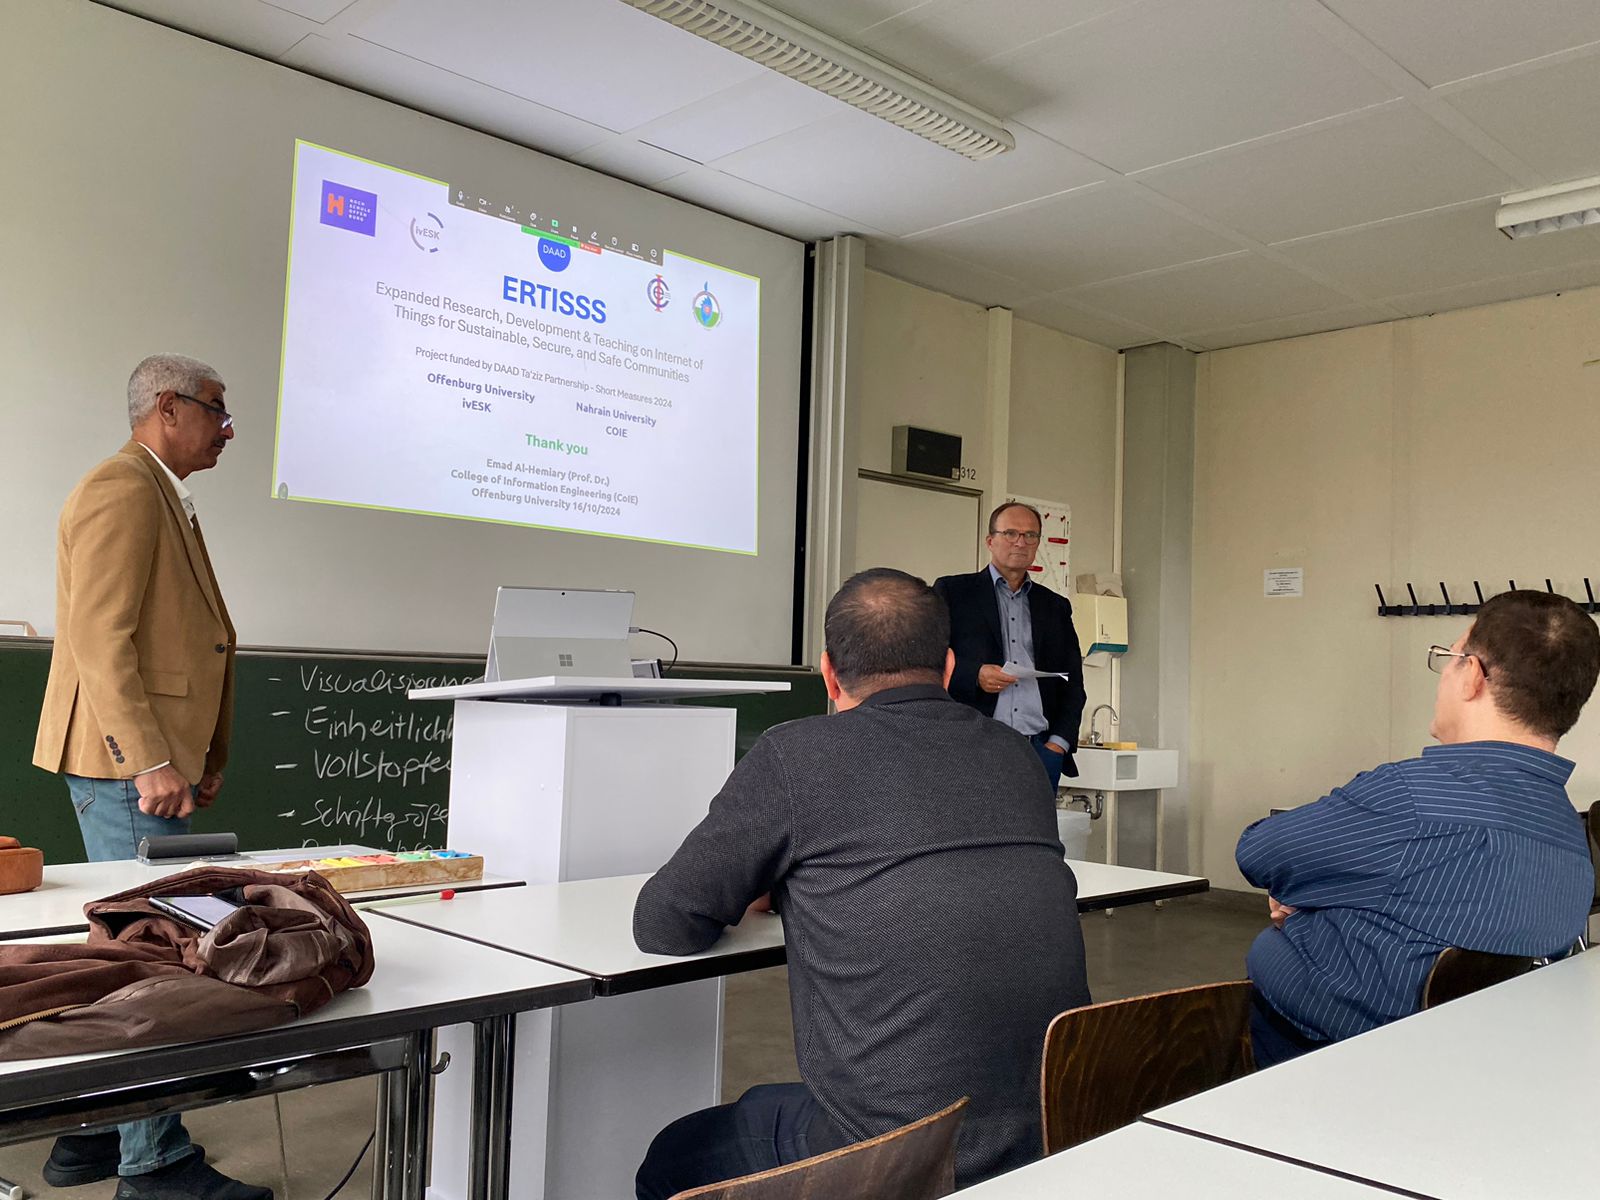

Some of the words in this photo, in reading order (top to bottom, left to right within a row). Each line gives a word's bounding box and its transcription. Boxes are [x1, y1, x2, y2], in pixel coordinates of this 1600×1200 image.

[415, 226, 440, 240] ivESK
[542, 244, 567, 259] DAAD
[503, 275, 606, 324] ERTISSS
[375, 281, 440, 308] Expanded
[443, 297, 503, 324] Research,
[506, 312, 581, 341] Development
[583, 331, 592, 344] &
[593, 333, 639, 358] Teaching
[640, 348, 653, 358] on
[655, 348, 694, 369] Internet
[693, 359, 704, 371] of
[394, 304, 435, 327] Things
[438, 315, 455, 330] for
[457, 319, 530, 348] Sustainable,
[532, 336, 574, 358] Secure,
[576, 348, 597, 362] and
[598, 352, 622, 368] Safe
[624, 357, 690, 383] Communities
[415, 346, 448, 363] Project
[449, 354, 480, 368] funded
[481, 360, 493, 372] by
[494, 363, 520, 376] DAAD
[544, 373, 590, 391] Partnership
[595, 384, 616, 397] Short
[617, 390, 653, 405] Measures
[654, 396, 673, 409] 2024
[427, 372, 482, 394] Offenburg
[484, 383, 536, 404] University
[462, 397, 492, 413] ivESK
[576, 401, 611, 418] Nahrain
[612, 409, 657, 428] University
[525, 433, 564, 452] Thank
[565, 442, 589, 456] you
[450, 469, 489, 484] College
[490, 474, 502, 485] of
[503, 474, 559, 493] Information
[560, 485, 612, 503] Engineering
[613, 491, 640, 506] (CoIE)
[486, 458, 513, 471] Emad
[514, 463, 566, 481] Al-Hemiary
[567, 470, 593, 484] (Prof.
[594, 476, 611, 488] Dr.)
[960, 466, 976, 480] 312
[471, 487, 522, 504] Offenburg
[524, 495, 571, 511] University
[572, 501, 622, 516] 16/10/2024
